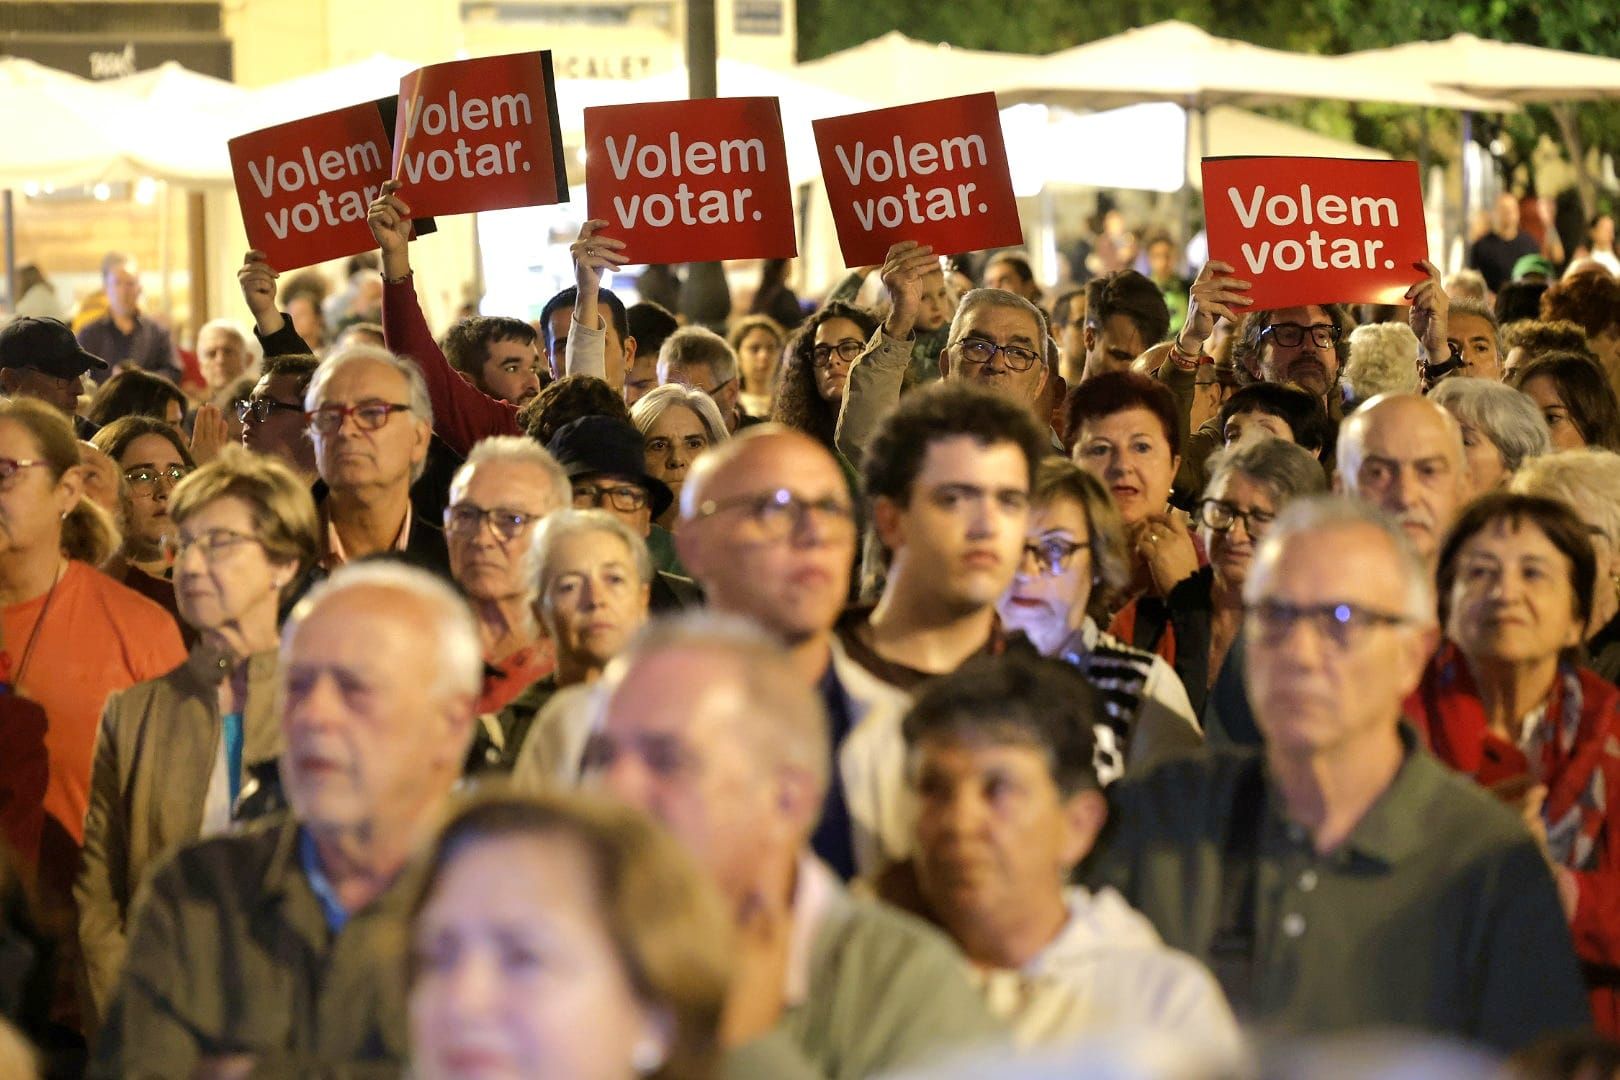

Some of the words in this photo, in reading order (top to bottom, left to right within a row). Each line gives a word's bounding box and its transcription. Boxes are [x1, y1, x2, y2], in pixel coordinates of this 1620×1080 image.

[404, 90, 532, 139] Volem
[247, 140, 383, 199] Volem
[404, 138, 532, 185] votar.
[605, 130, 766, 180] Volem
[835, 134, 988, 186] Volem
[613, 183, 762, 229] votar.
[852, 182, 988, 231] votar.
[1227, 183, 1399, 229] Volem
[1241, 230, 1395, 275] votar.
